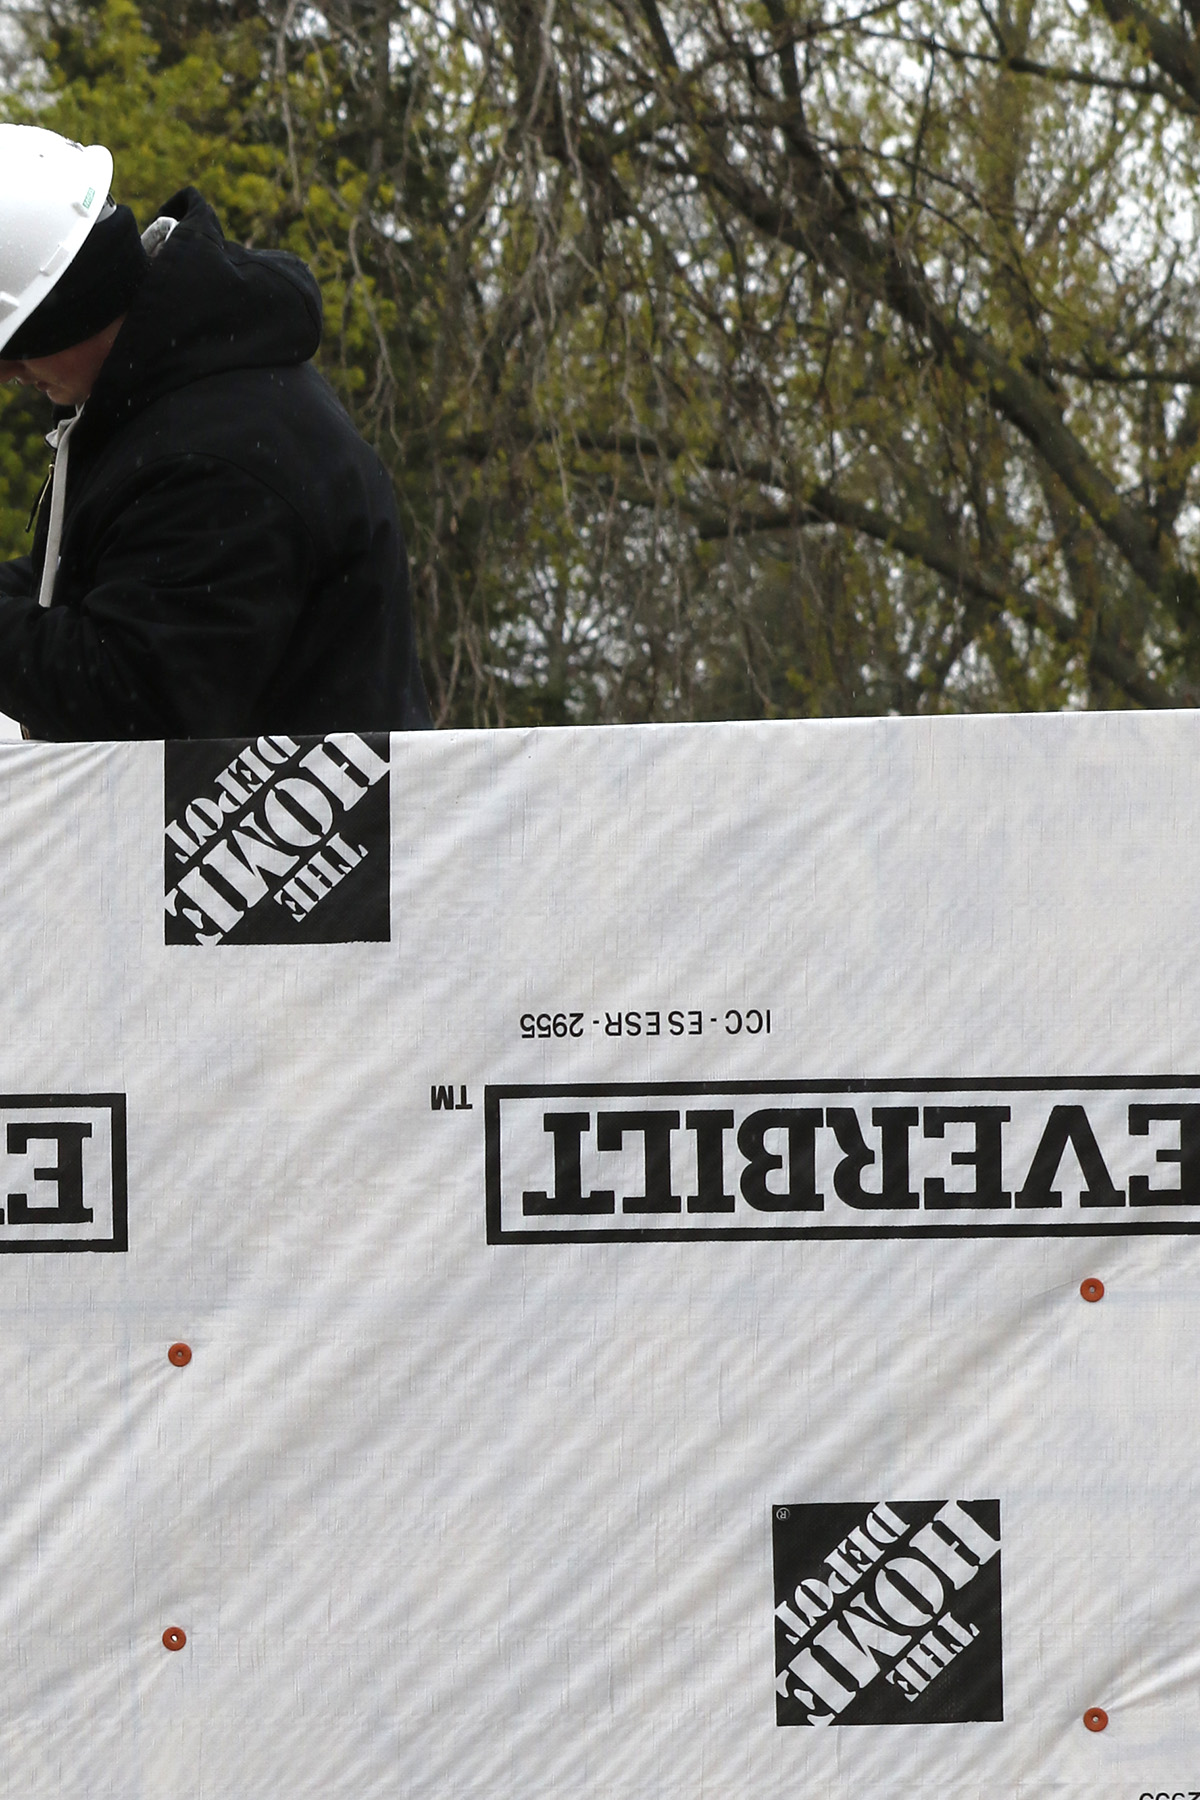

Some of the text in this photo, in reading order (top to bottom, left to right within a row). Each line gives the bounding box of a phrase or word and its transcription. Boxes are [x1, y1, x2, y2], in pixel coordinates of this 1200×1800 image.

[164, 734, 300, 865] DEPOT
[164, 732, 390, 946] HOME
[273, 833, 369, 922] THE
[519, 1012, 584, 1039] 2955
[605, 1011, 660, 1037] ESR
[668, 1010, 703, 1036] ES
[726, 1009, 771, 1035] ICC
[522, 1104, 1200, 1217] EVERBILT
[774, 1502, 911, 1646] DEPOT
[775, 1500, 1001, 1727] HOME
[885, 1612, 980, 1703] THE
